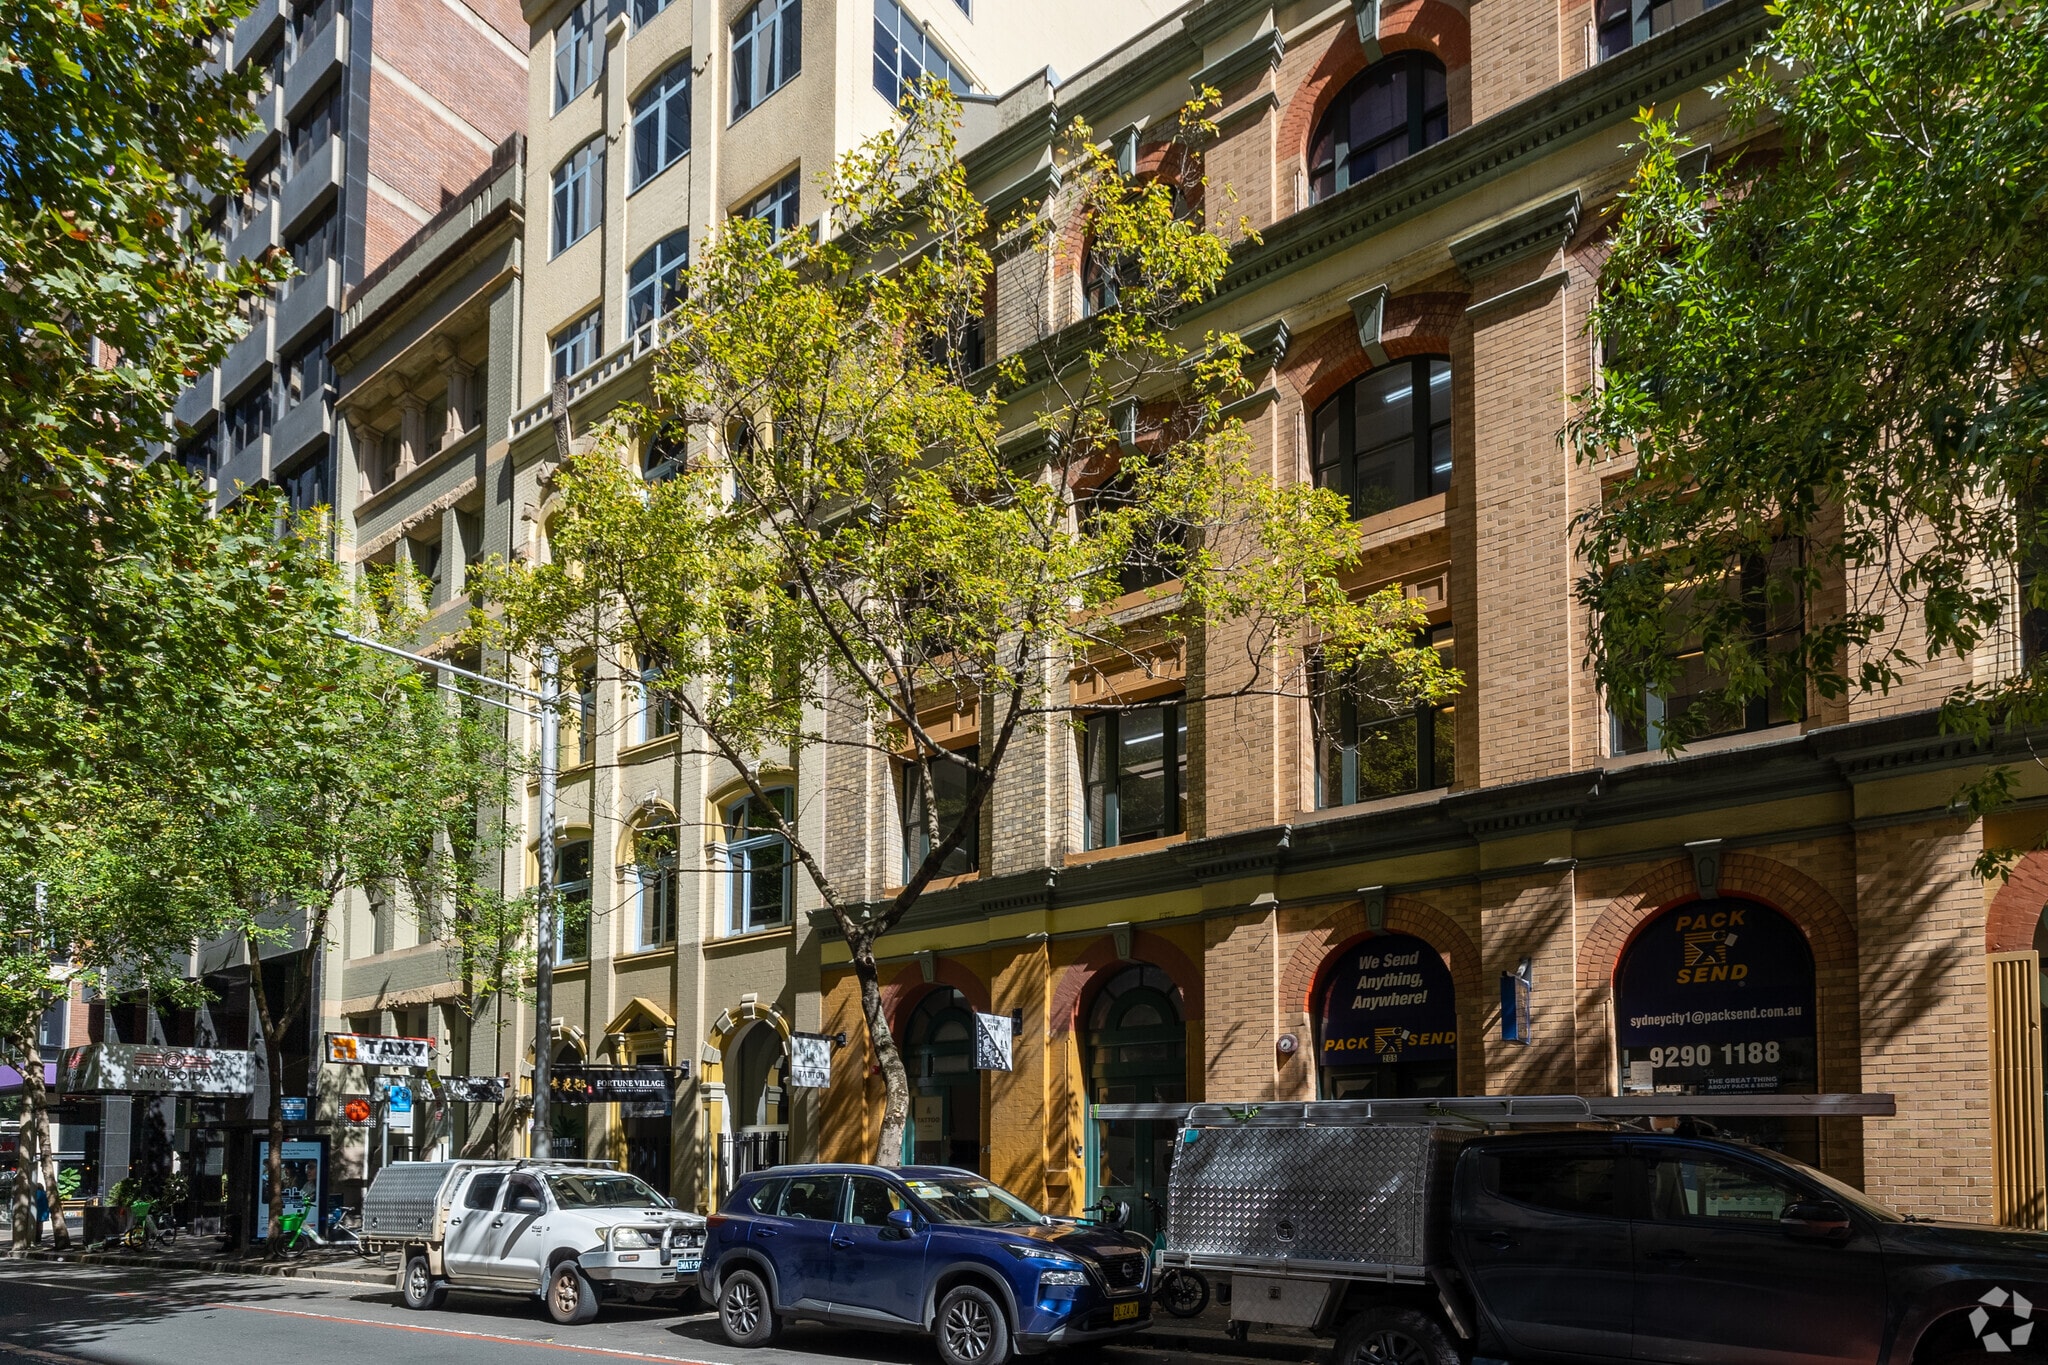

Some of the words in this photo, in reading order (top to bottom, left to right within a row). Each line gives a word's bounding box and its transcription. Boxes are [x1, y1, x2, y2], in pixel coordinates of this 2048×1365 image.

[1675, 909, 1747, 932] PACK
[1360, 956, 1379, 970] We
[1383, 951, 1420, 968] Send
[1357, 972, 1423, 991] Anything,
[1676, 964, 1748, 984] SEND
[1351, 990, 1428, 1010] Anywhere!
[1630, 1006, 1802, 1028] sydneycity1@packsend.com.au
[1324, 1037, 1369, 1052] PACK
[1408, 1031, 1457, 1046] SEND
[1383, 1054, 1397, 1062] 205
[1650, 1044, 1711, 1068] 9290
[1720, 1041, 1780, 1065] 1188
[133, 1069, 212, 1083] NYMBOIDA
[597, 1079, 633, 1087] FORTUNE
[634, 1079, 665, 1087] VILLAGE
[798, 1070, 825, 1080] TATTOO
